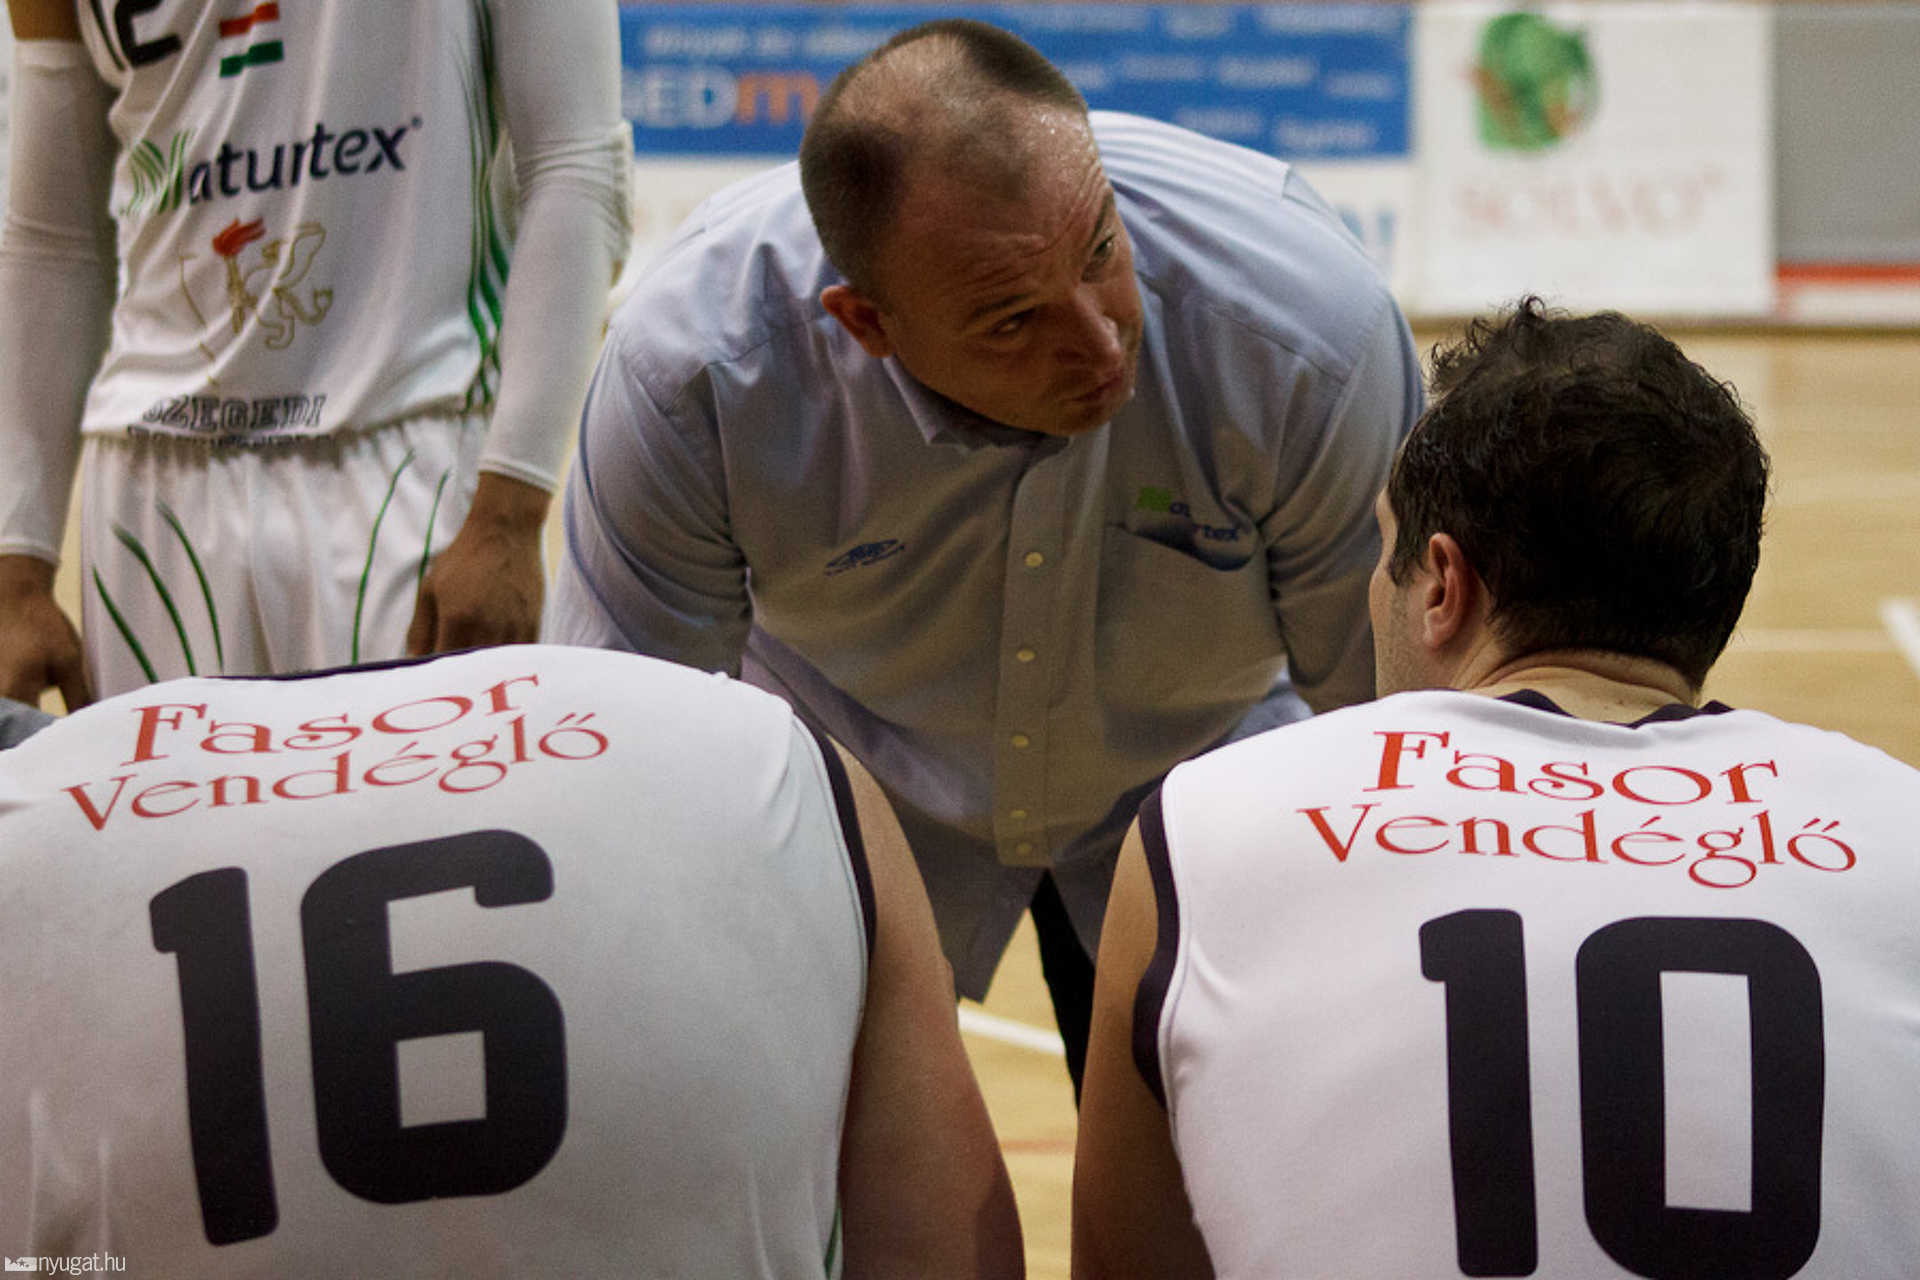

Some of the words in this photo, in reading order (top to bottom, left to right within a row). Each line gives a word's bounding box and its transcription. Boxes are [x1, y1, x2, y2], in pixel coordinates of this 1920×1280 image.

[60, 711, 610, 832] Vendéglő
[120, 673, 540, 766] Fasor
[1362, 730, 1779, 806] Fasor
[1296, 802, 1858, 889] Vendéglő
[148, 828, 570, 1247] 16
[1418, 907, 1826, 1280] 10
